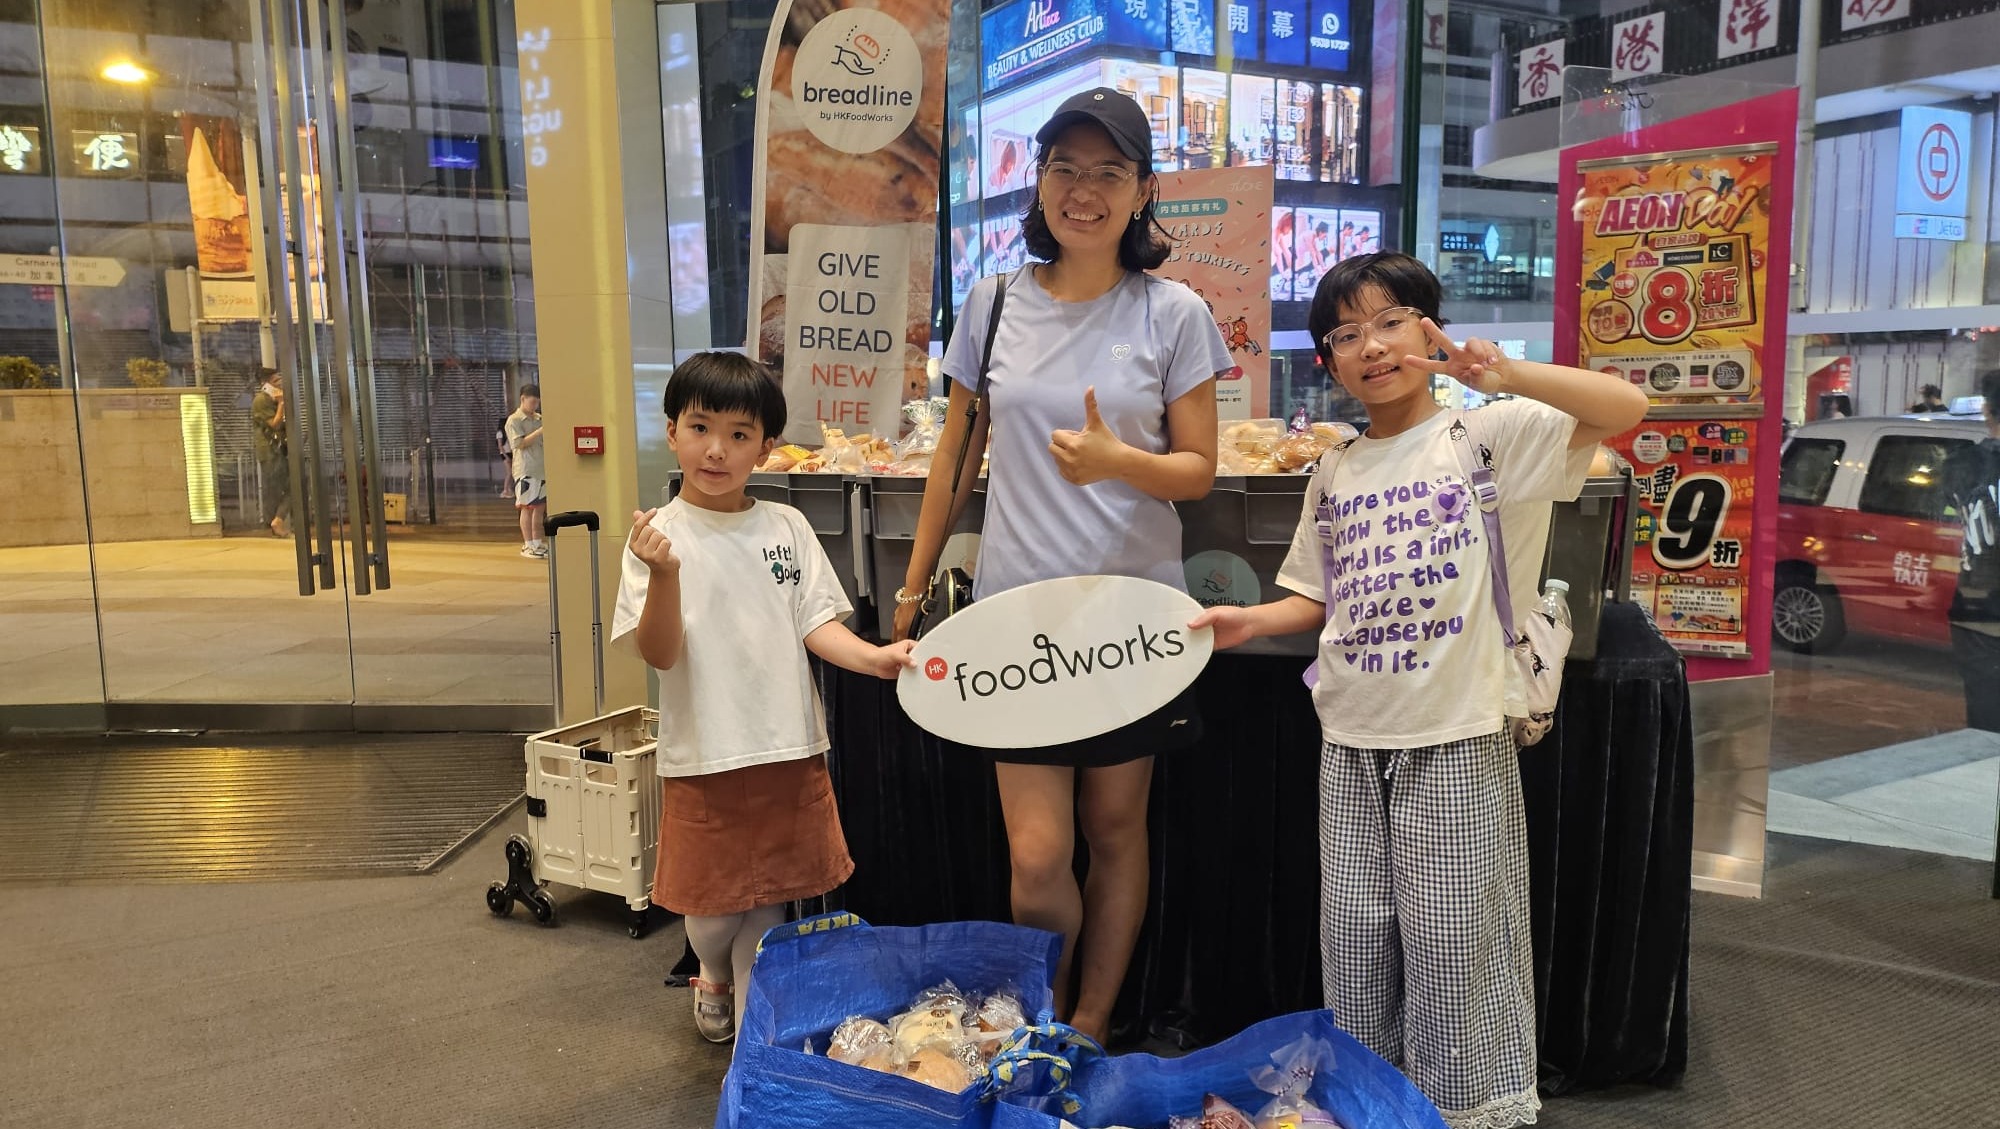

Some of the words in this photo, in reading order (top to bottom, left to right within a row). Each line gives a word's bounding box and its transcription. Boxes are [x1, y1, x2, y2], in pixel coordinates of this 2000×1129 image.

[987, 56, 1018, 79] BEAUTY
[1021, 51, 1028, 66] &
[1030, 27, 1076, 60] WELLNESS
[1078, 15, 1104, 40] CLUB
[804, 81, 912, 106] breadline
[820, 110, 831, 120] by
[833, 111, 893, 122] HKFoodWorks
[1597, 193, 1685, 236] AEON
[818, 253, 880, 278] GIVE
[1702, 267, 1739, 305] 折
[818, 290, 876, 315] OLD
[1642, 270, 1692, 339] 8
[800, 326, 892, 353] BREAD
[811, 364, 877, 388] NEW
[817, 400, 871, 424] LIFE
[1658, 477, 1726, 561] 9
[762, 544, 792, 562] left!
[1406, 539, 1423, 560] a
[1713, 540, 1740, 565] 折
[1893, 550, 1931, 571] 的士
[1408, 561, 1460, 588] the
[1892, 566, 1929, 588] TAXI
[928, 662, 945, 675] HK
[953, 623, 1186, 702] foodworks
[797, 912, 860, 936] IKEA
